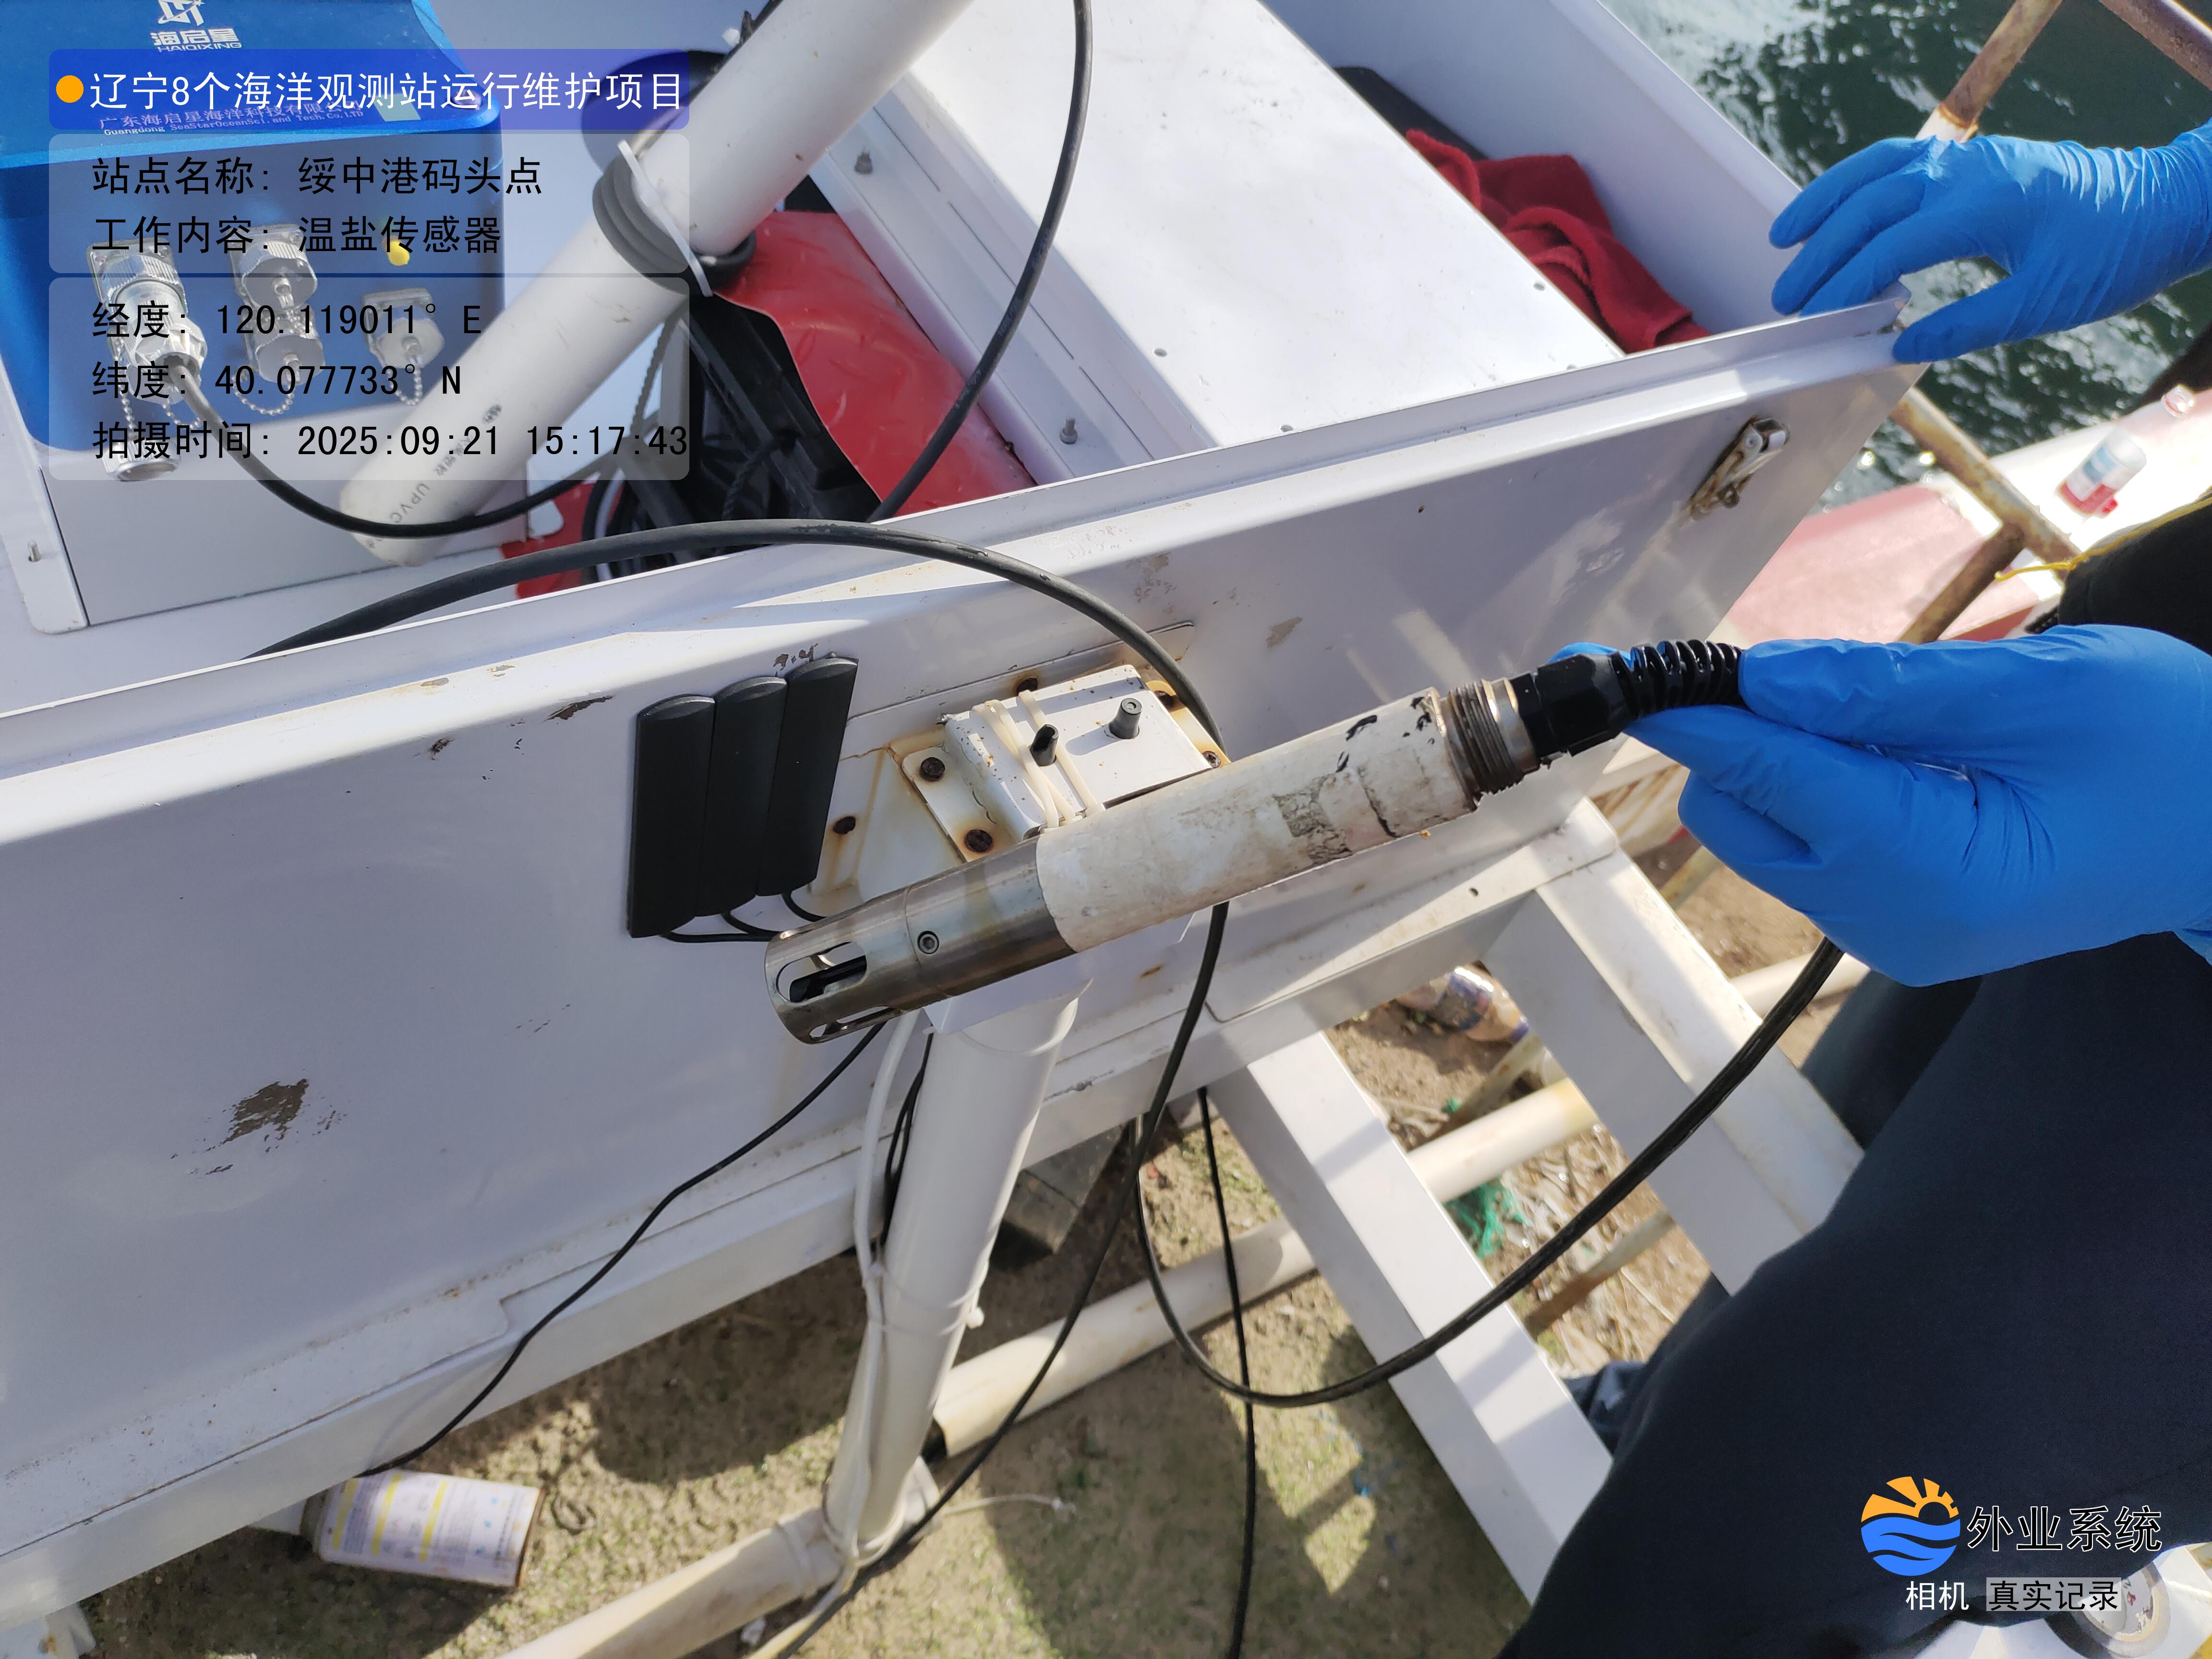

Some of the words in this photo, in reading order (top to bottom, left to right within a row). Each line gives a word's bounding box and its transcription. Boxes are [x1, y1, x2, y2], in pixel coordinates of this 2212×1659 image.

[150, 28, 240, 46] 海启星
[157, 42, 242, 53] HAIQIXING
[104, 126, 165, 136] Guangdong
[390, 482, 431, 524] UPVC
